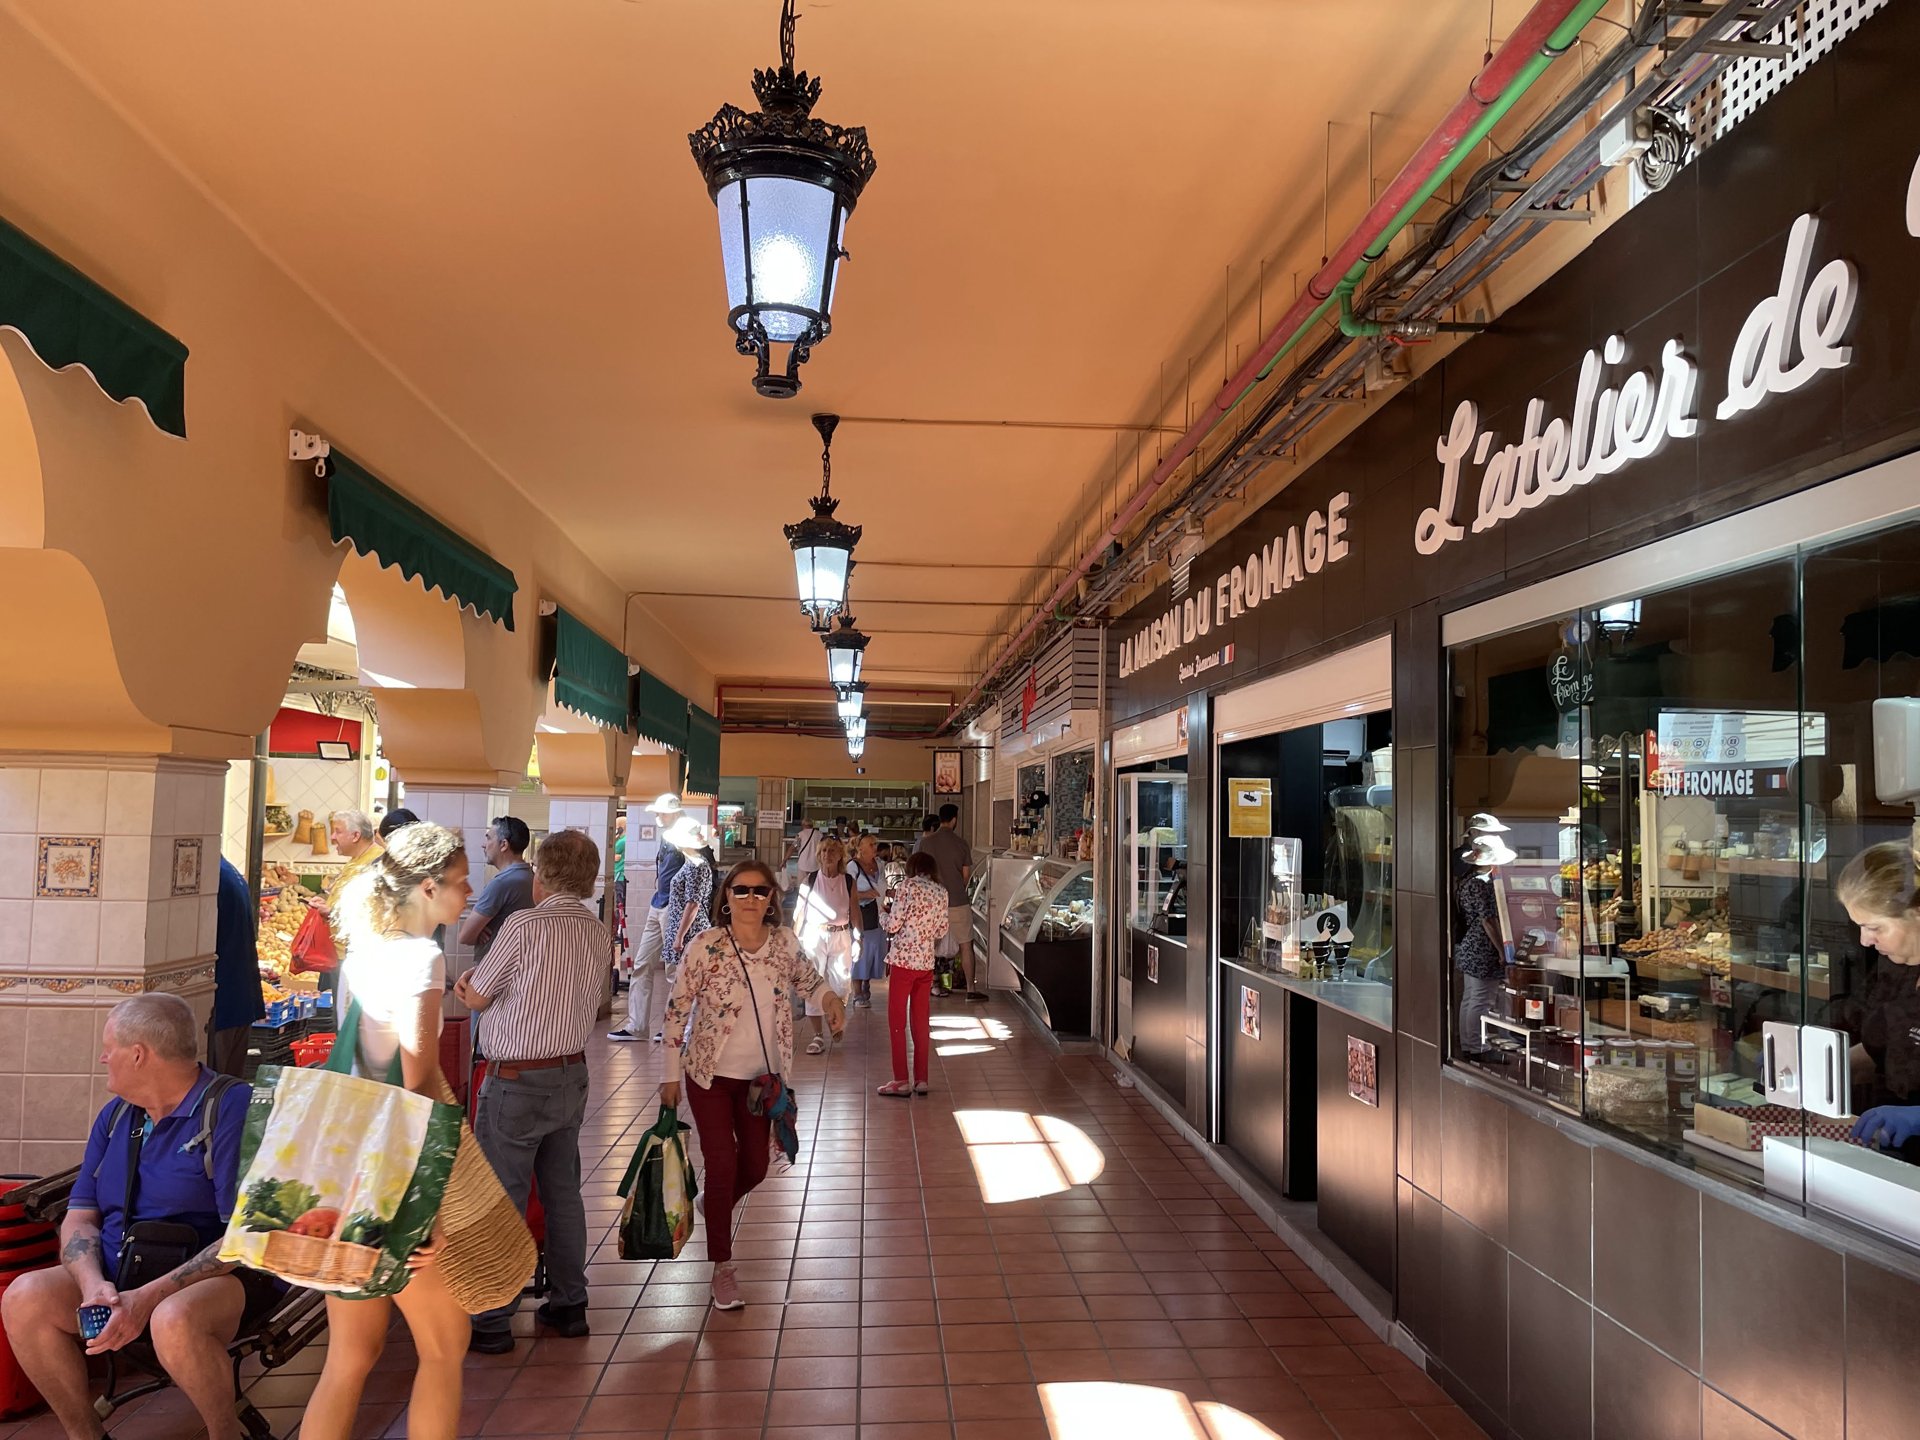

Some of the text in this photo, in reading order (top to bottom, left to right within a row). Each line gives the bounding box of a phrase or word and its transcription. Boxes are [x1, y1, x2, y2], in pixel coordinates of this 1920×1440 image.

[1414, 213, 1858, 555] L'atelier de
[1119, 637, 1135, 679] LA
[1134, 604, 1181, 671] MAISON
[1183, 586, 1212, 645] DU
[1215, 491, 1350, 626] FROMAGE
[1551, 655, 1575, 685] Le
[1553, 673, 1593, 706] fromge
[1664, 769, 1754, 796] DU FROMAGE
